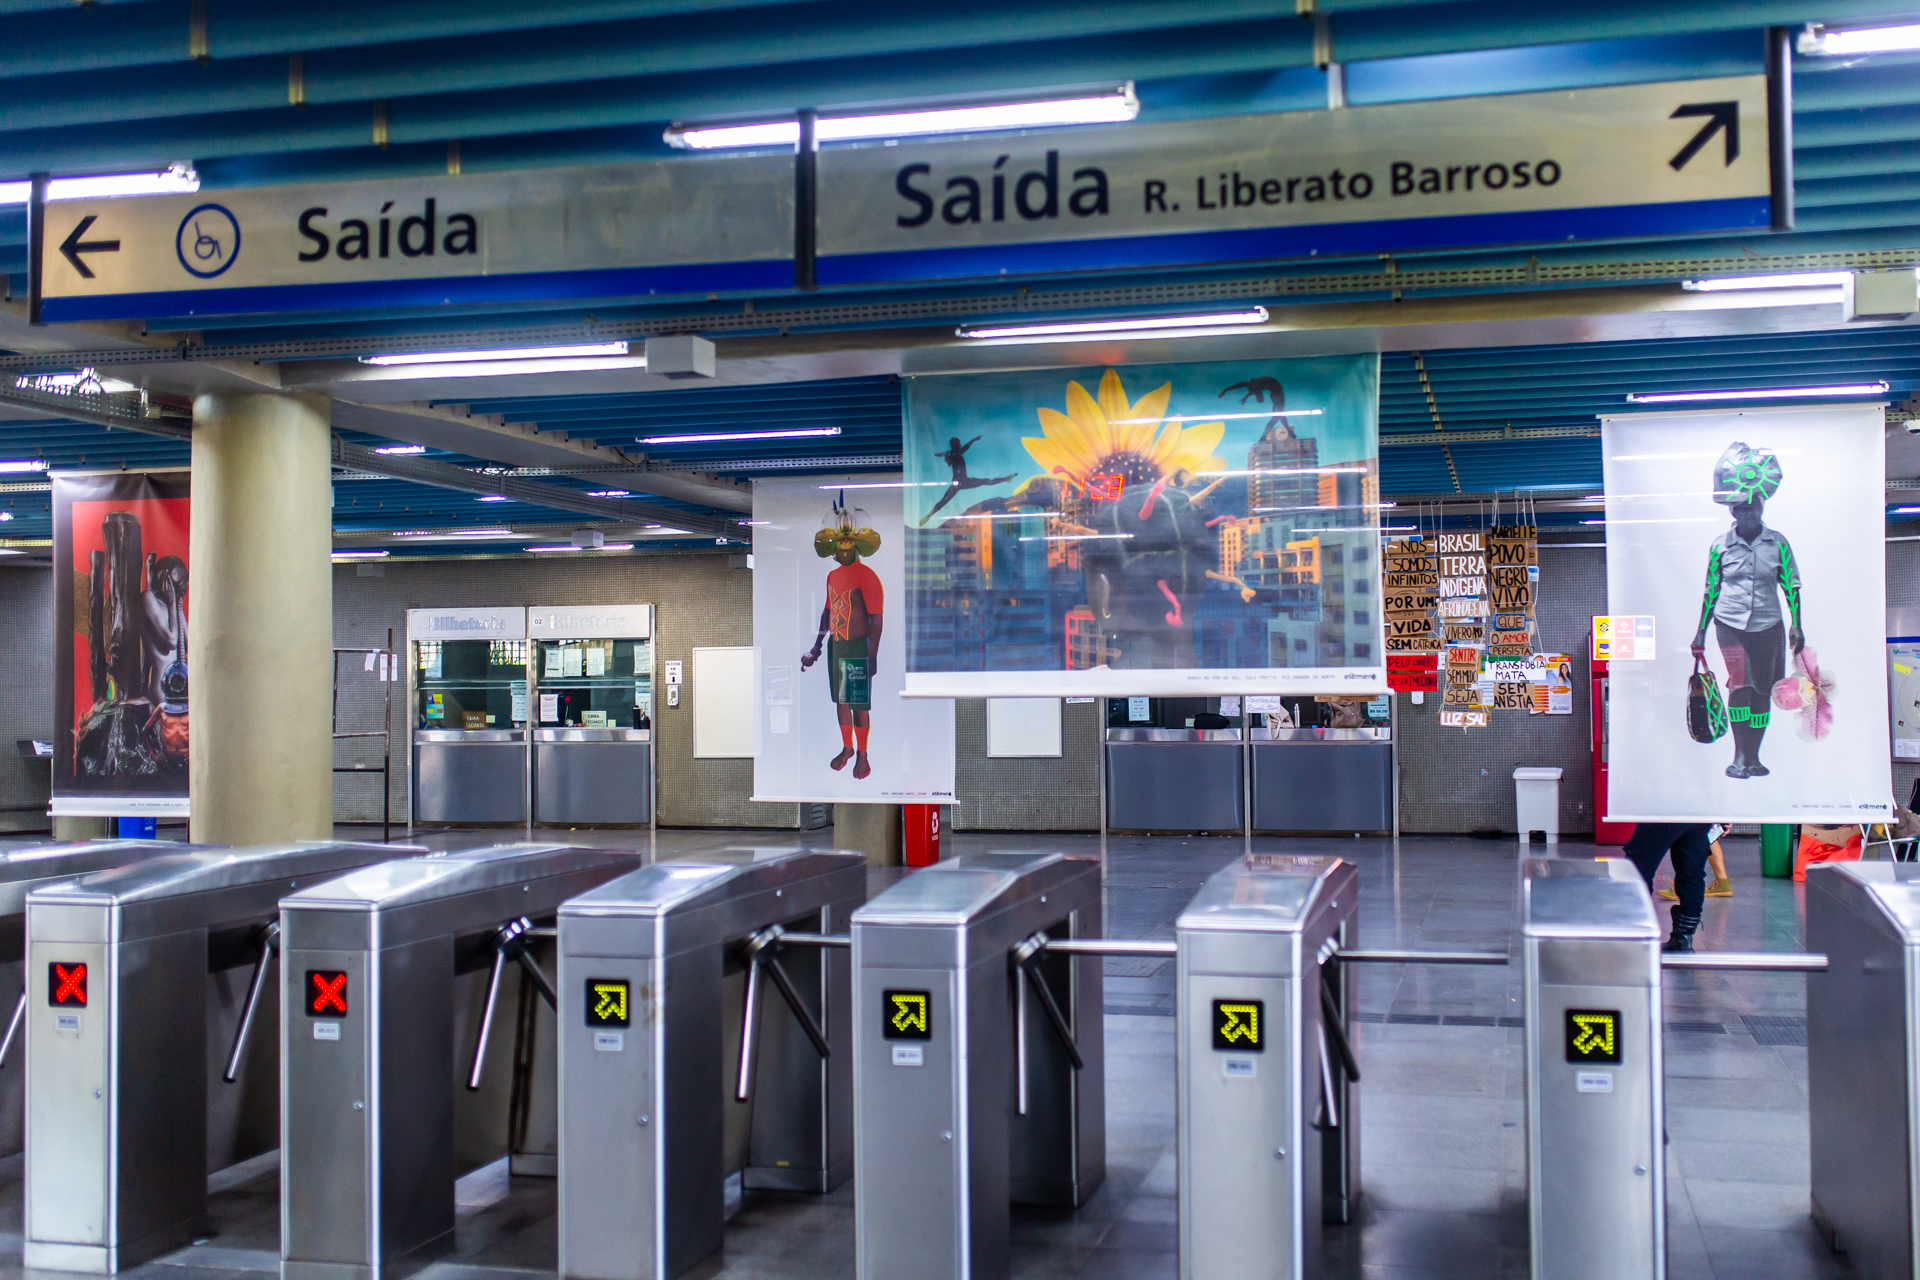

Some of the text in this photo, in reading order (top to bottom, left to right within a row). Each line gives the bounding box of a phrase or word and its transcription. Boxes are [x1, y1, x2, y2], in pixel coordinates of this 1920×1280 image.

[893, 149, 1563, 228] Saída R. Liberato Barroso
[298, 197, 477, 262] Saída
[1439, 534, 1485, 553] BRASIL
[1491, 544, 1525, 563] POVO
[1393, 557, 1432, 572] SOMOS
[1440, 555, 1488, 575] TERRA
[1388, 573, 1437, 586] INFINITOS
[1491, 566, 1528, 587] NEGRO
[1385, 596, 1414, 609] POR
[1492, 586, 1529, 608] VIVO
[429, 615, 505, 631] Bilheteria
[549, 614, 629, 629] Bilheteria
[1393, 619, 1432, 634] VIDA
[1498, 616, 1523, 628] QUE
[1386, 638, 1442, 650] SEM CATRACA
[1502, 632, 1529, 643] AMOR
[1449, 649, 1476, 662] SENTIR
[1492, 647, 1532, 655] PERSISTA
[1388, 658, 1411, 668] PELO
[1489, 661, 1545, 670] TRANSFOBIA
[1495, 671, 1527, 680] MATA
[1498, 683, 1527, 694] SEM
[1445, 690, 1479, 702] SEJA
[1494, 695, 1534, 708] ANISTIA
[1440, 712, 1463, 726] LUZ
[1466, 713, 1487, 726] SAL
